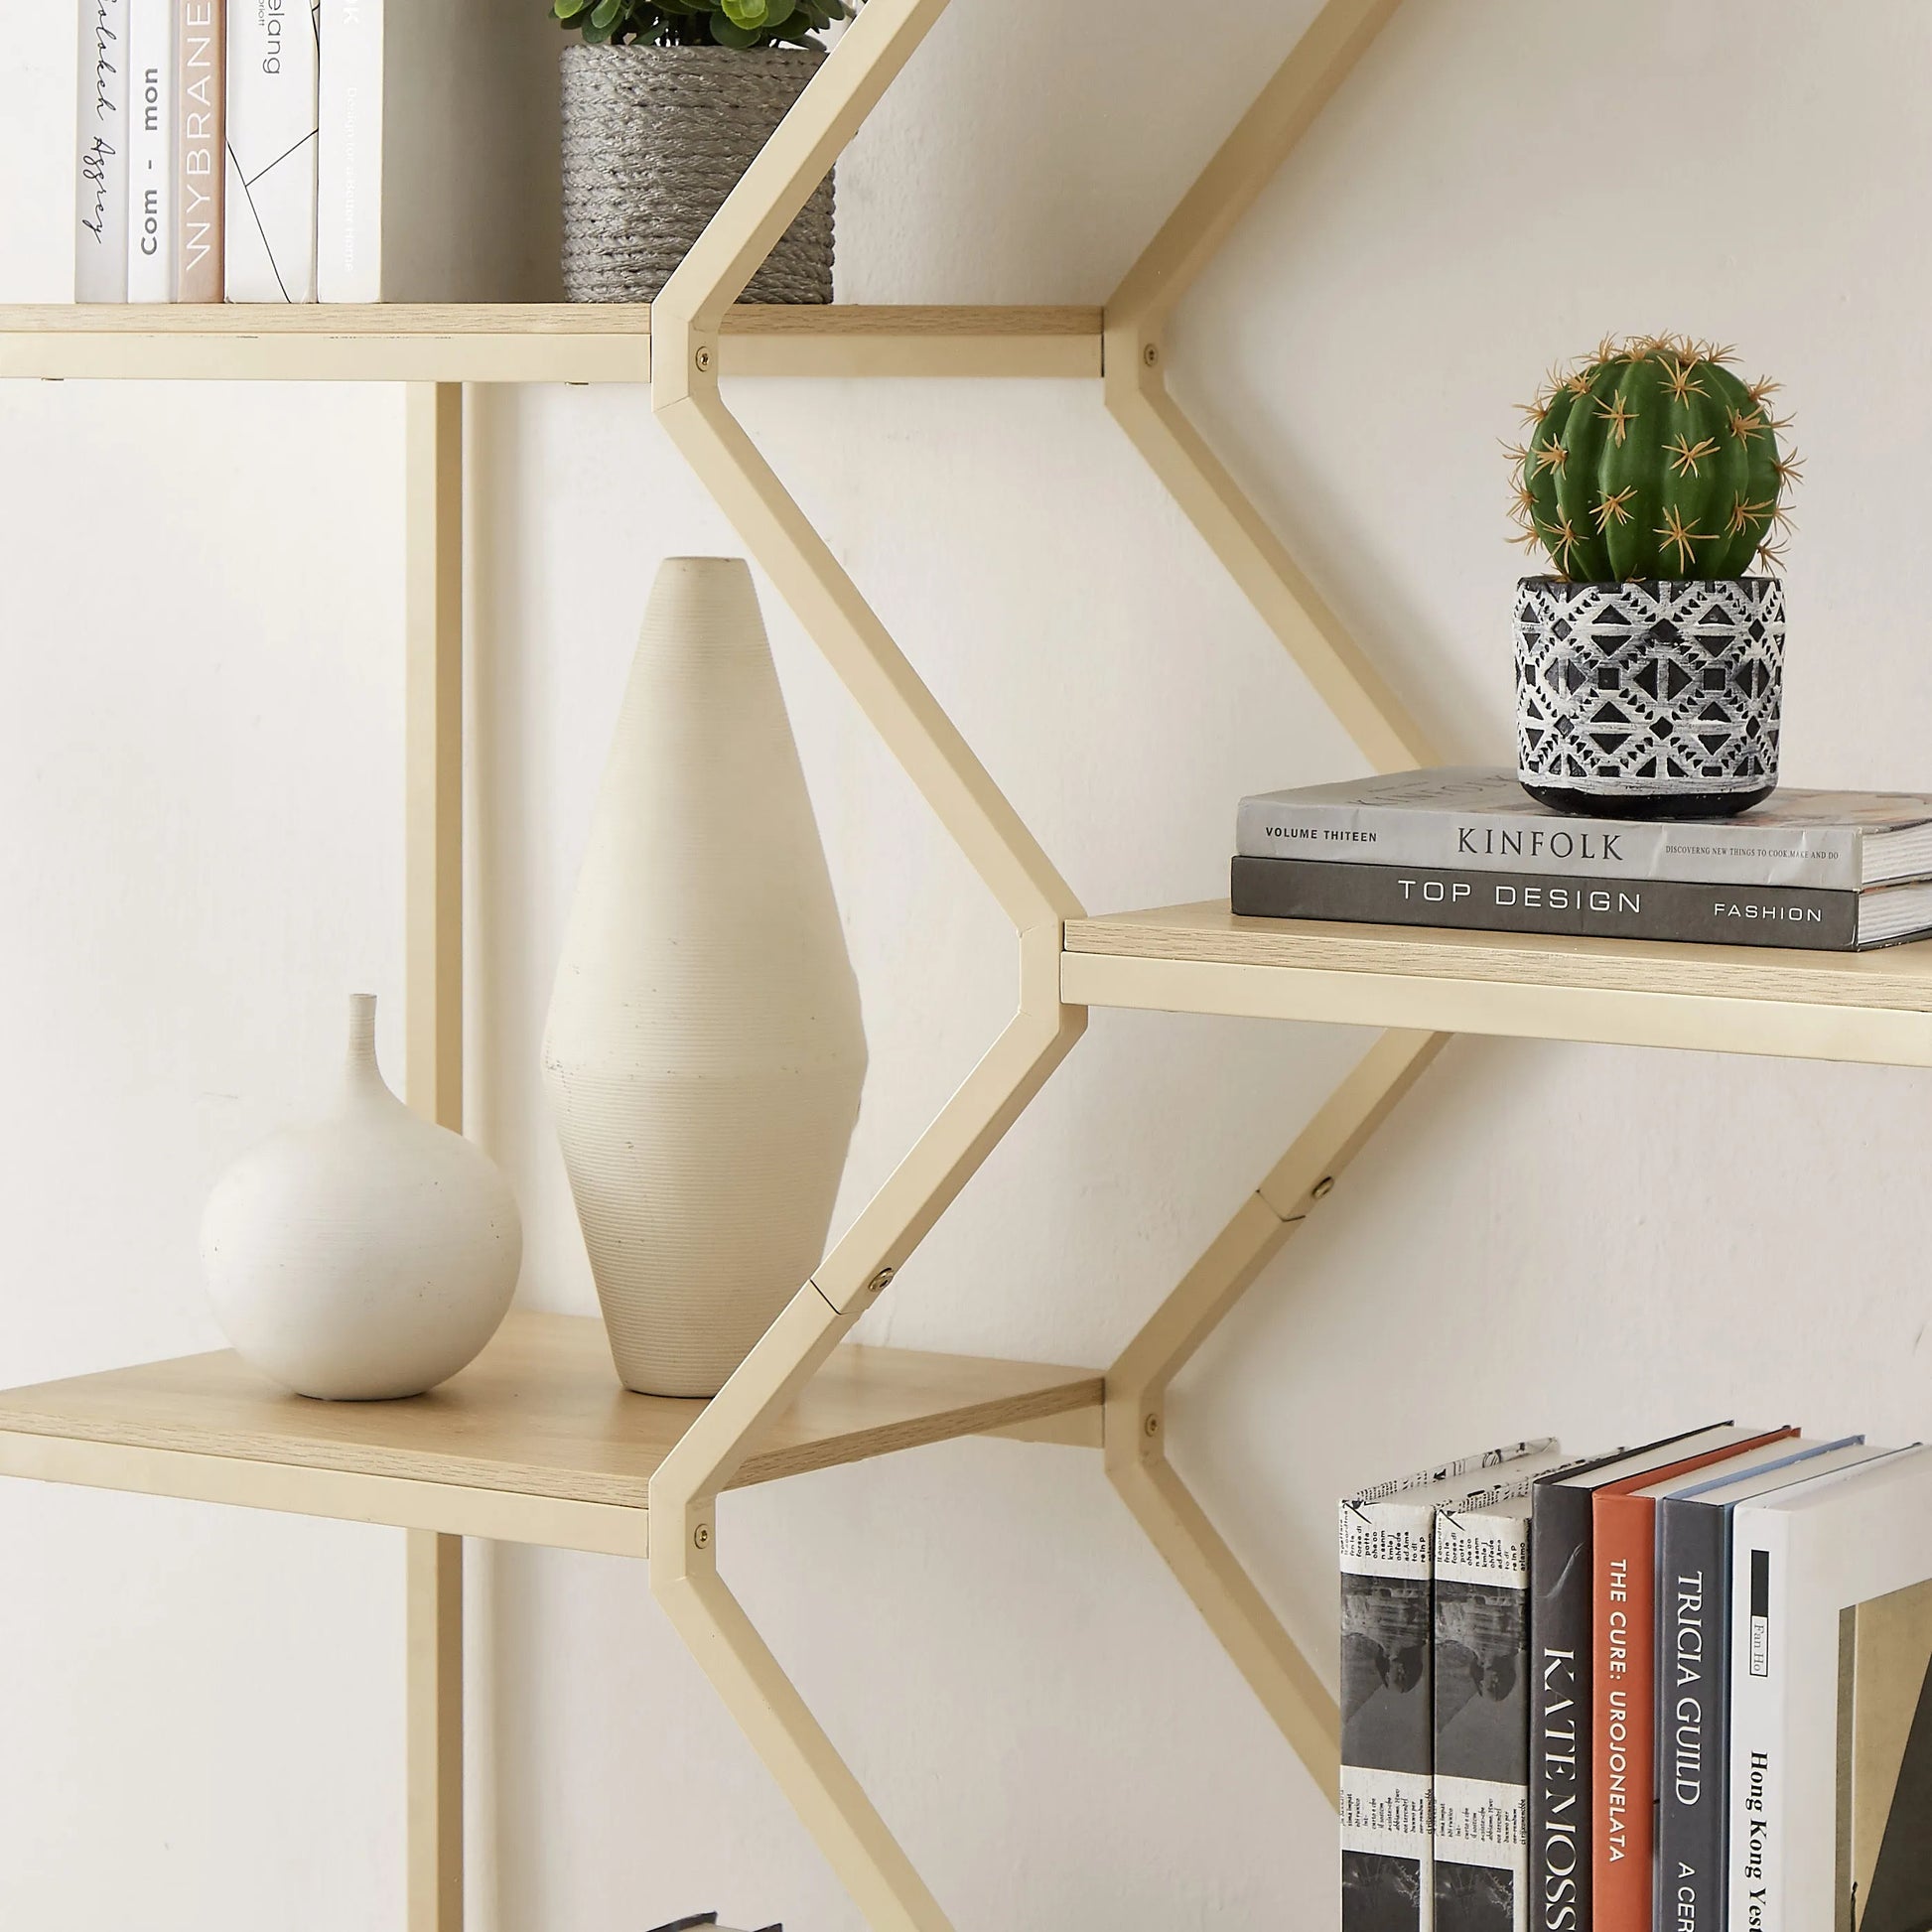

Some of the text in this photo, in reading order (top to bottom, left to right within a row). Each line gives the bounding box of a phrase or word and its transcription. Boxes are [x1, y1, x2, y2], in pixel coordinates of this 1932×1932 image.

[145, 69, 158, 130] mon
[1266, 827, 1376, 842] VOLUME THITEEN
[1458, 828, 1623, 860] KINFOLK
[1729, 848, 1755, 857] THINGS
[1398, 881, 1641, 912] TOP DESIGN
[1715, 903, 1821, 921] FASHION
[1754, 1624, 1764, 1671] Fan Ho
[1609, 1560, 1626, 1862] THE CURE: UROJONELATA
[1676, 1571, 1702, 1805] TRICIA GUILD
[1544, 1647, 1576, 1930] KATE MOSS
[1745, 1751, 1767, 1812] Hong
[1679, 1863, 1695, 1877] A
[1744, 1819, 1767, 1879] Kong
